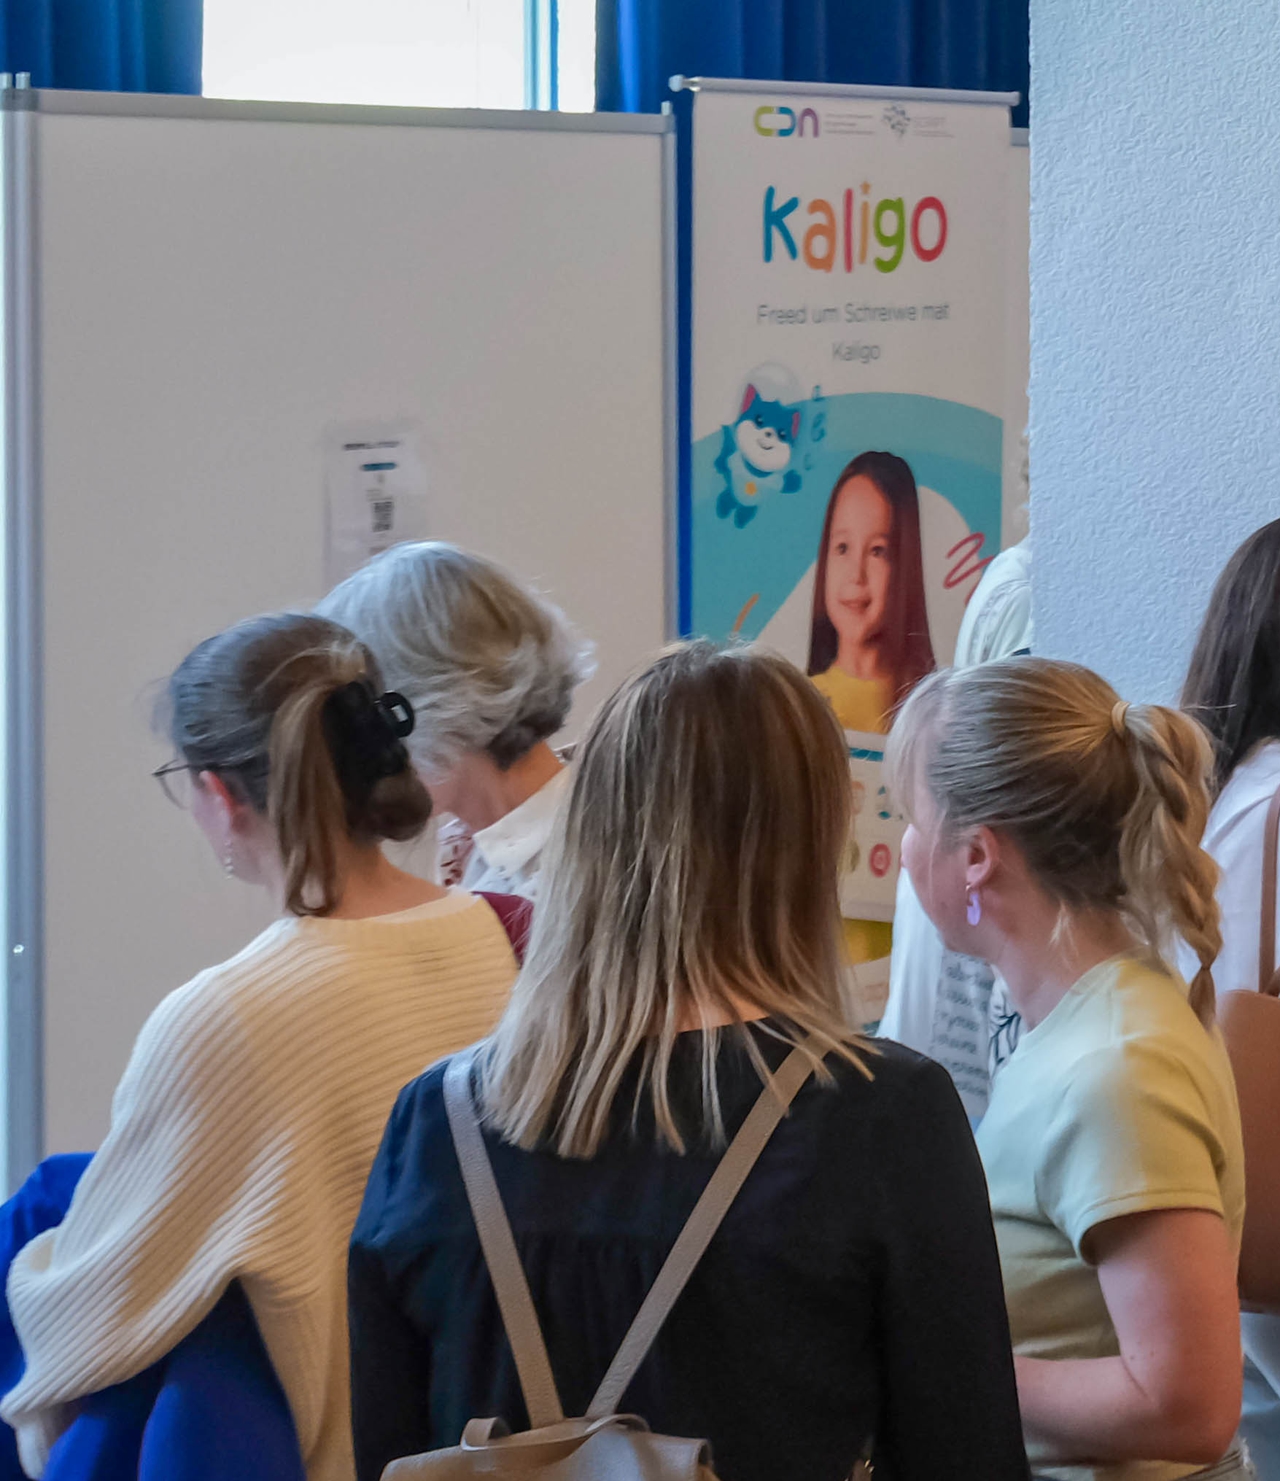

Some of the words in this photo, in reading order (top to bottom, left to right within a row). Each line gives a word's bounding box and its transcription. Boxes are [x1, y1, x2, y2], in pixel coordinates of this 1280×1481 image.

[757, 304, 806, 325] Freed
[812, 307, 839, 323] um
[921, 304, 950, 321] mat
[831, 340, 881, 365] Kaligo
